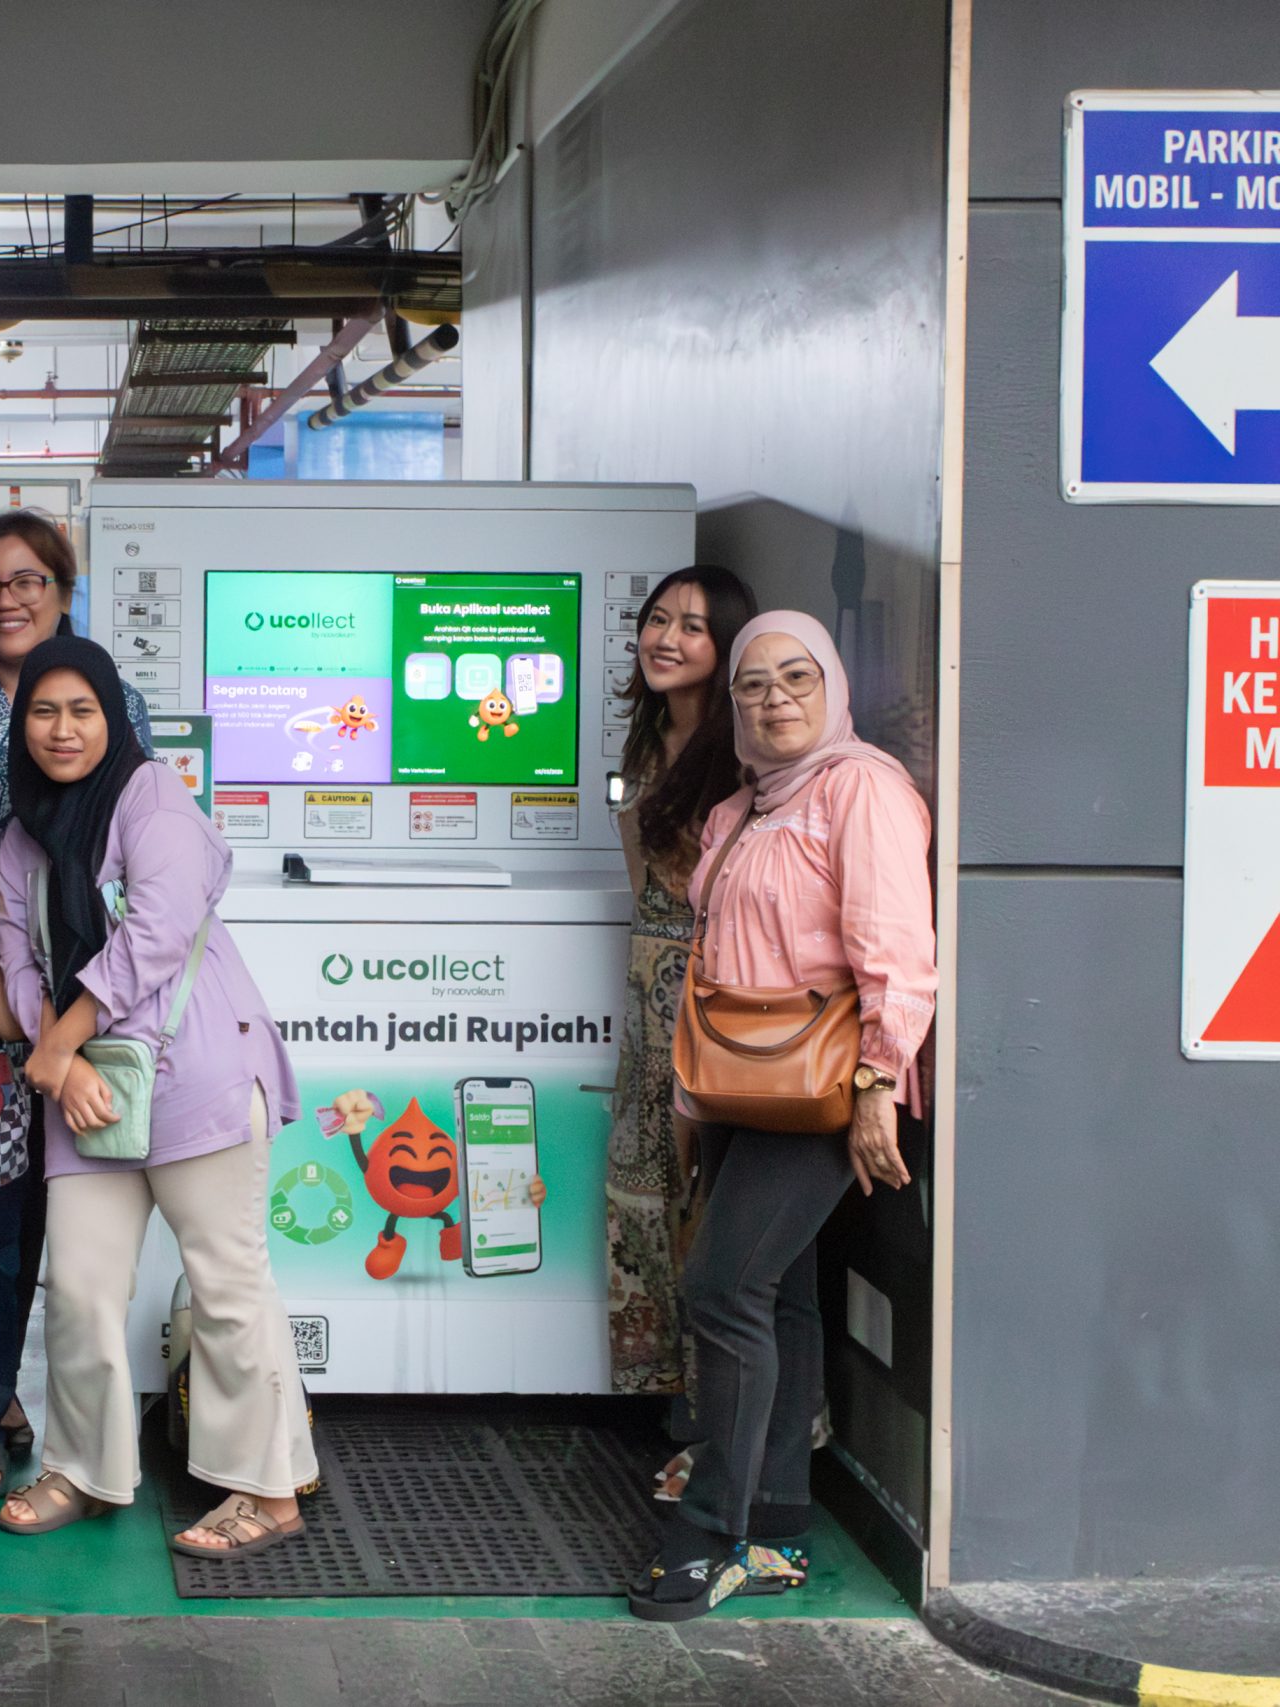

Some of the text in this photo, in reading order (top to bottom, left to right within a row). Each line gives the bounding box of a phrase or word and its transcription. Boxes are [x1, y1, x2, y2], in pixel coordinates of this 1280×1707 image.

[1164, 130, 1280, 164] PARKIR
[1095, 174, 1200, 209] MOBIL
[270, 612, 356, 629] ucollect
[420, 603, 551, 617] Buka Aplikasi ucollect
[1250, 616, 1279, 659] H
[212, 685, 307, 699] Segera Datang
[1223, 671, 1277, 714] KE
[363, 954, 505, 981] ucollect
[432, 986, 446, 998] by
[385, 1012, 457, 1051] jadi
[467, 1013, 612, 1052] Rupiah!
